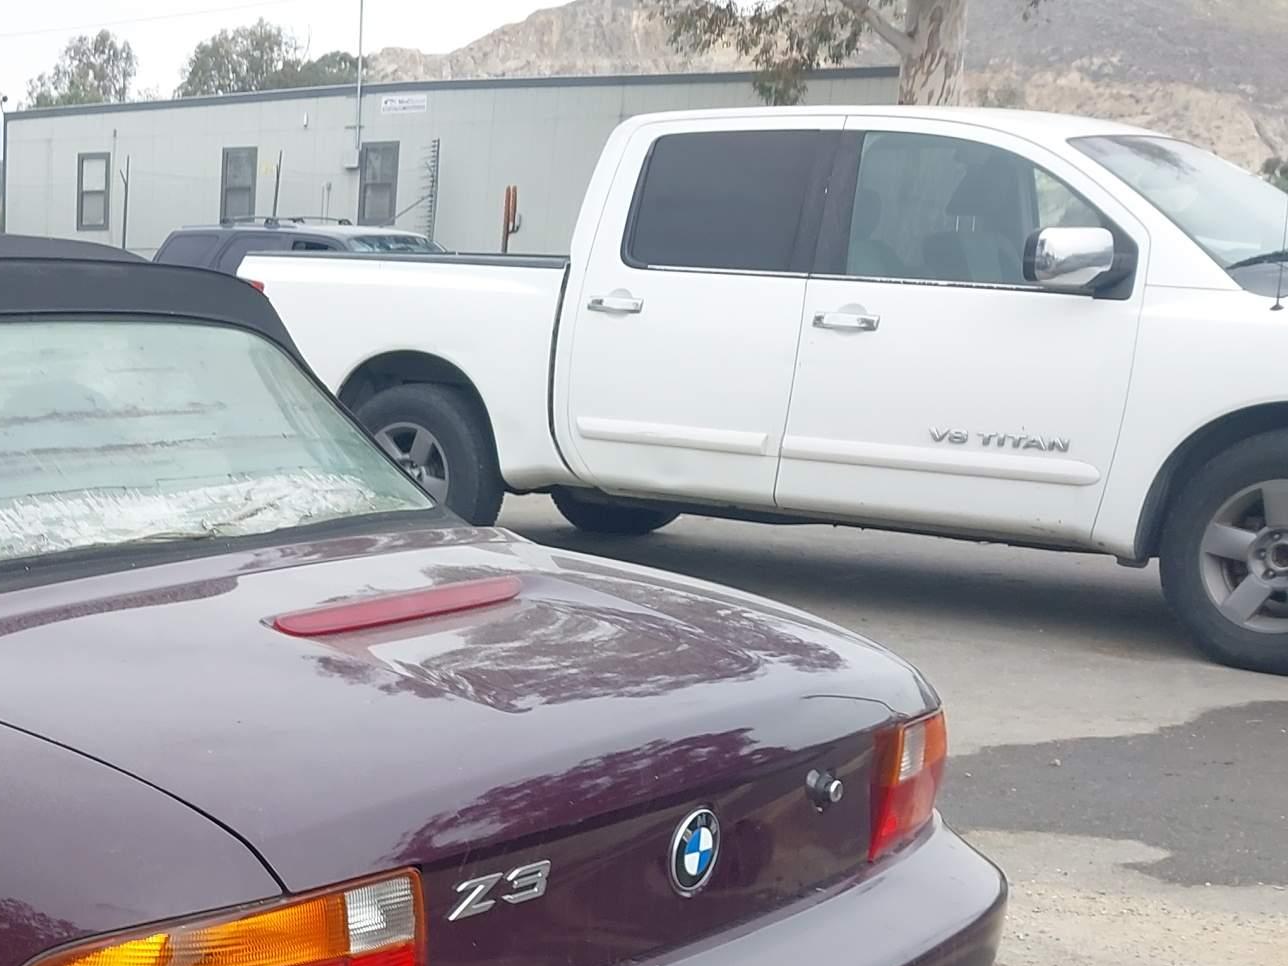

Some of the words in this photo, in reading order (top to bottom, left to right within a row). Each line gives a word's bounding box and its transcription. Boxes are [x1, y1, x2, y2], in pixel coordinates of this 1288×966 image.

[929, 426, 969, 445] V8
[977, 432, 1070, 453] TITAN
[682, 812, 717, 843] BMW
[447, 860, 552, 921] Z3
